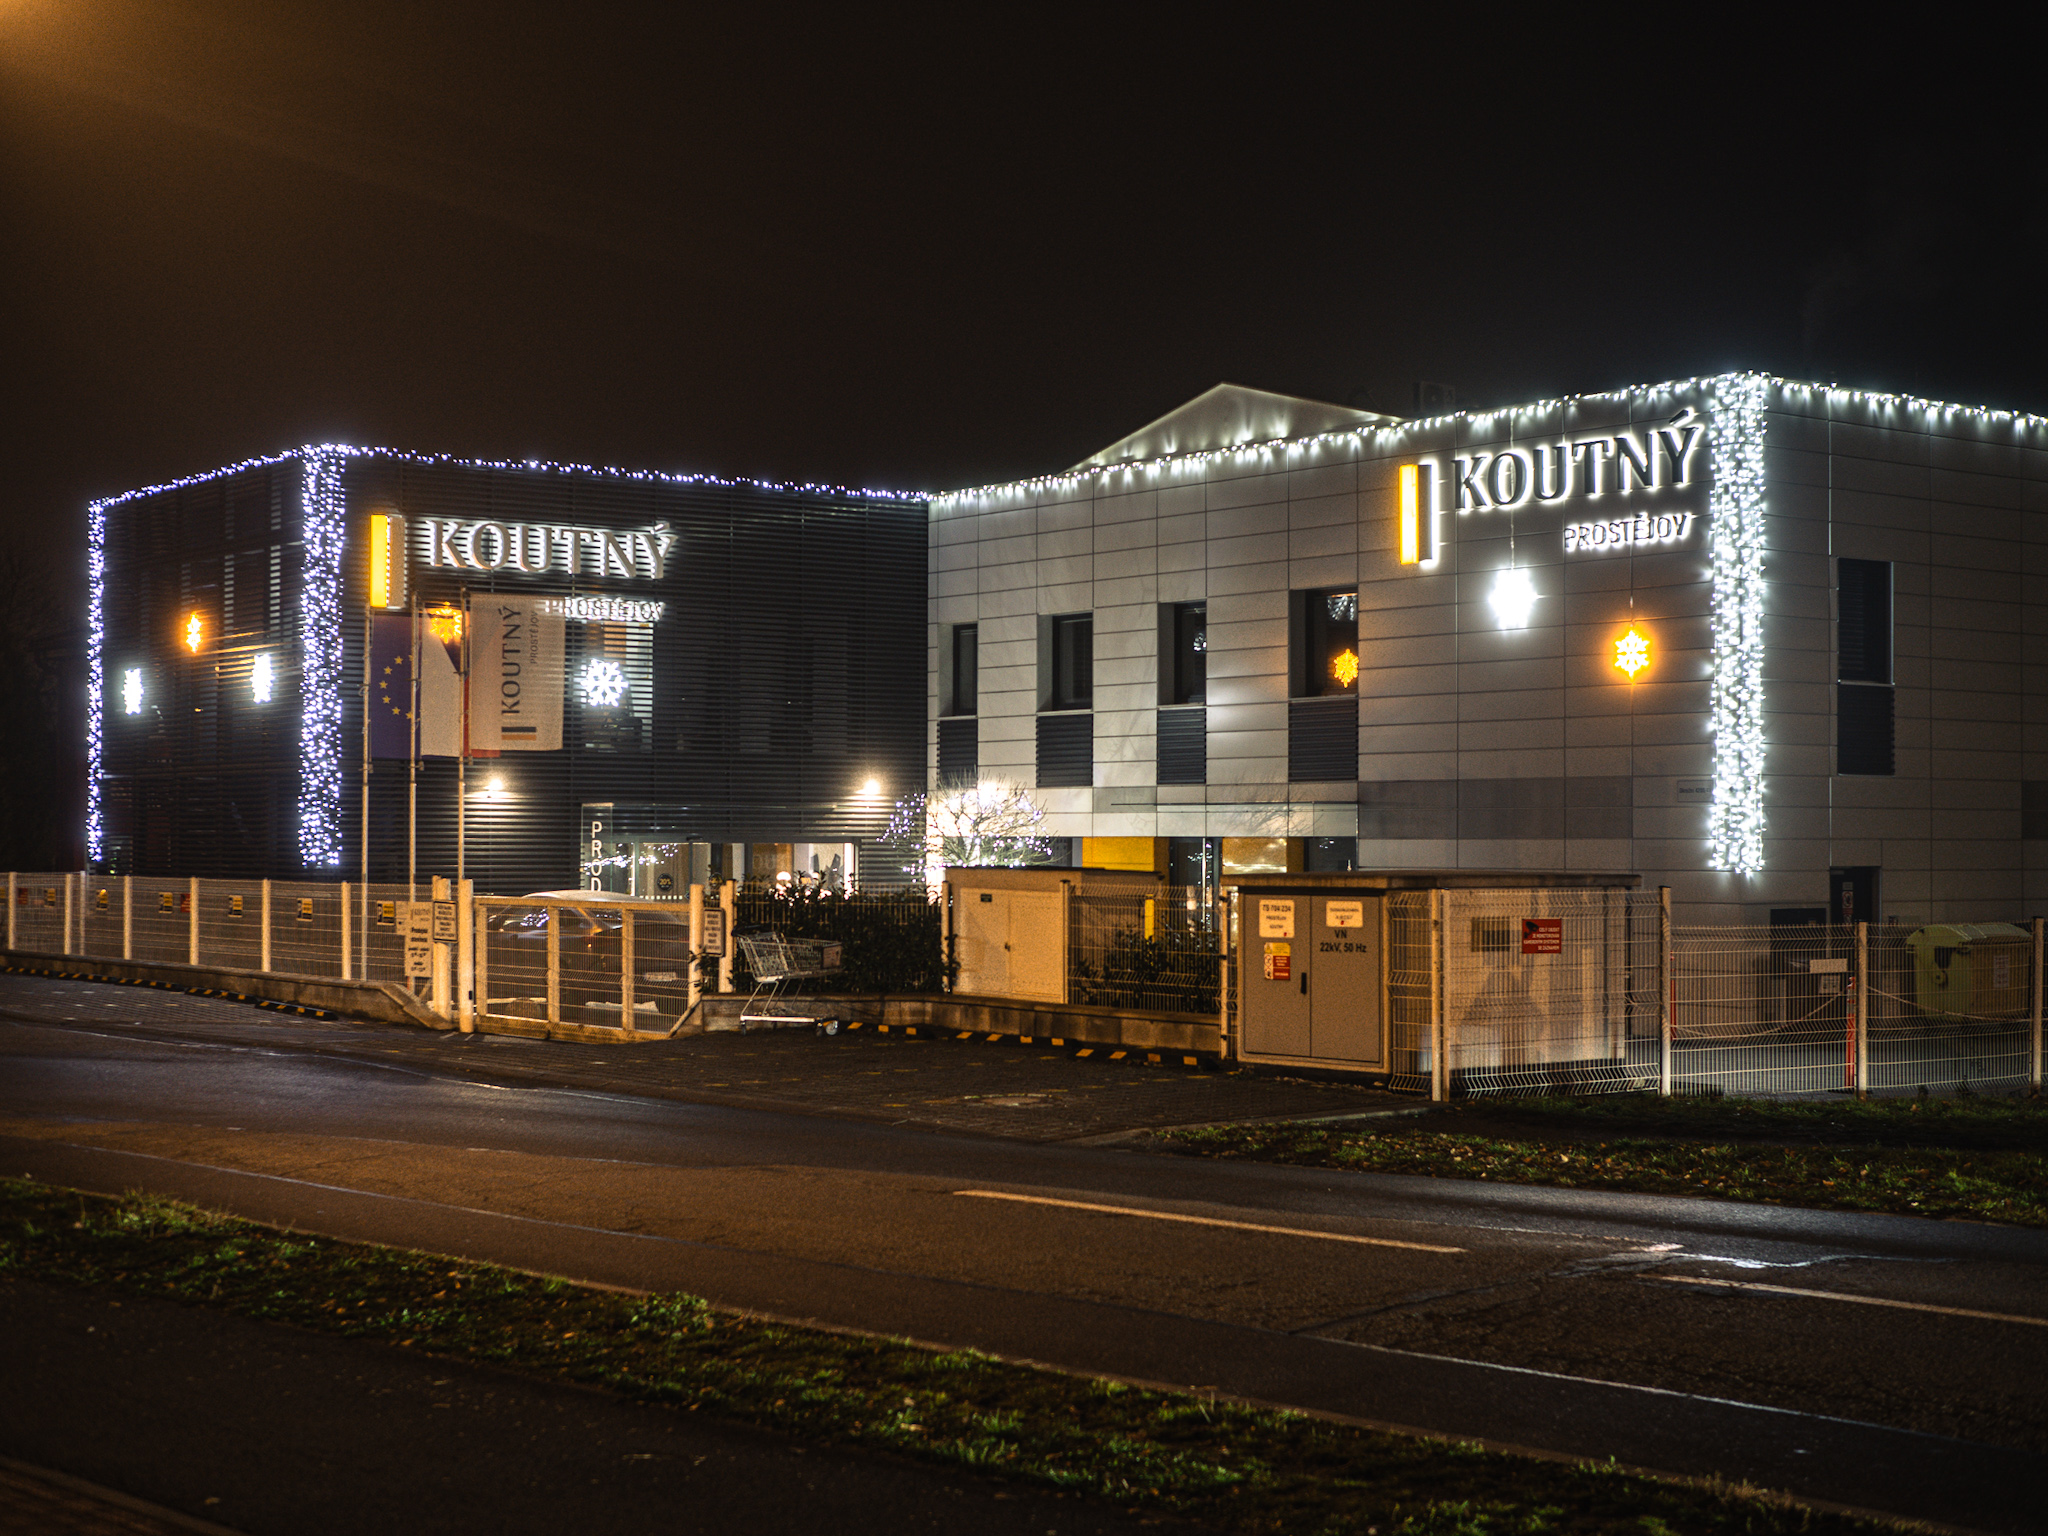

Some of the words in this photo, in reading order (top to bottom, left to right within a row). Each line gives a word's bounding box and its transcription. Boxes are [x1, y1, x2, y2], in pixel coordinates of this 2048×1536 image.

[1453, 409, 1701, 510] KOUTNÝ
[426, 521, 679, 580] KOUTNÝ
[1564, 514, 1693, 551] PROSTĚJOV
[498, 605, 523, 715] KOUTNÝ
[1334, 929, 1347, 939] VN
[1344, 943, 1354, 953] 50
[1356, 943, 1367, 953] Hz
